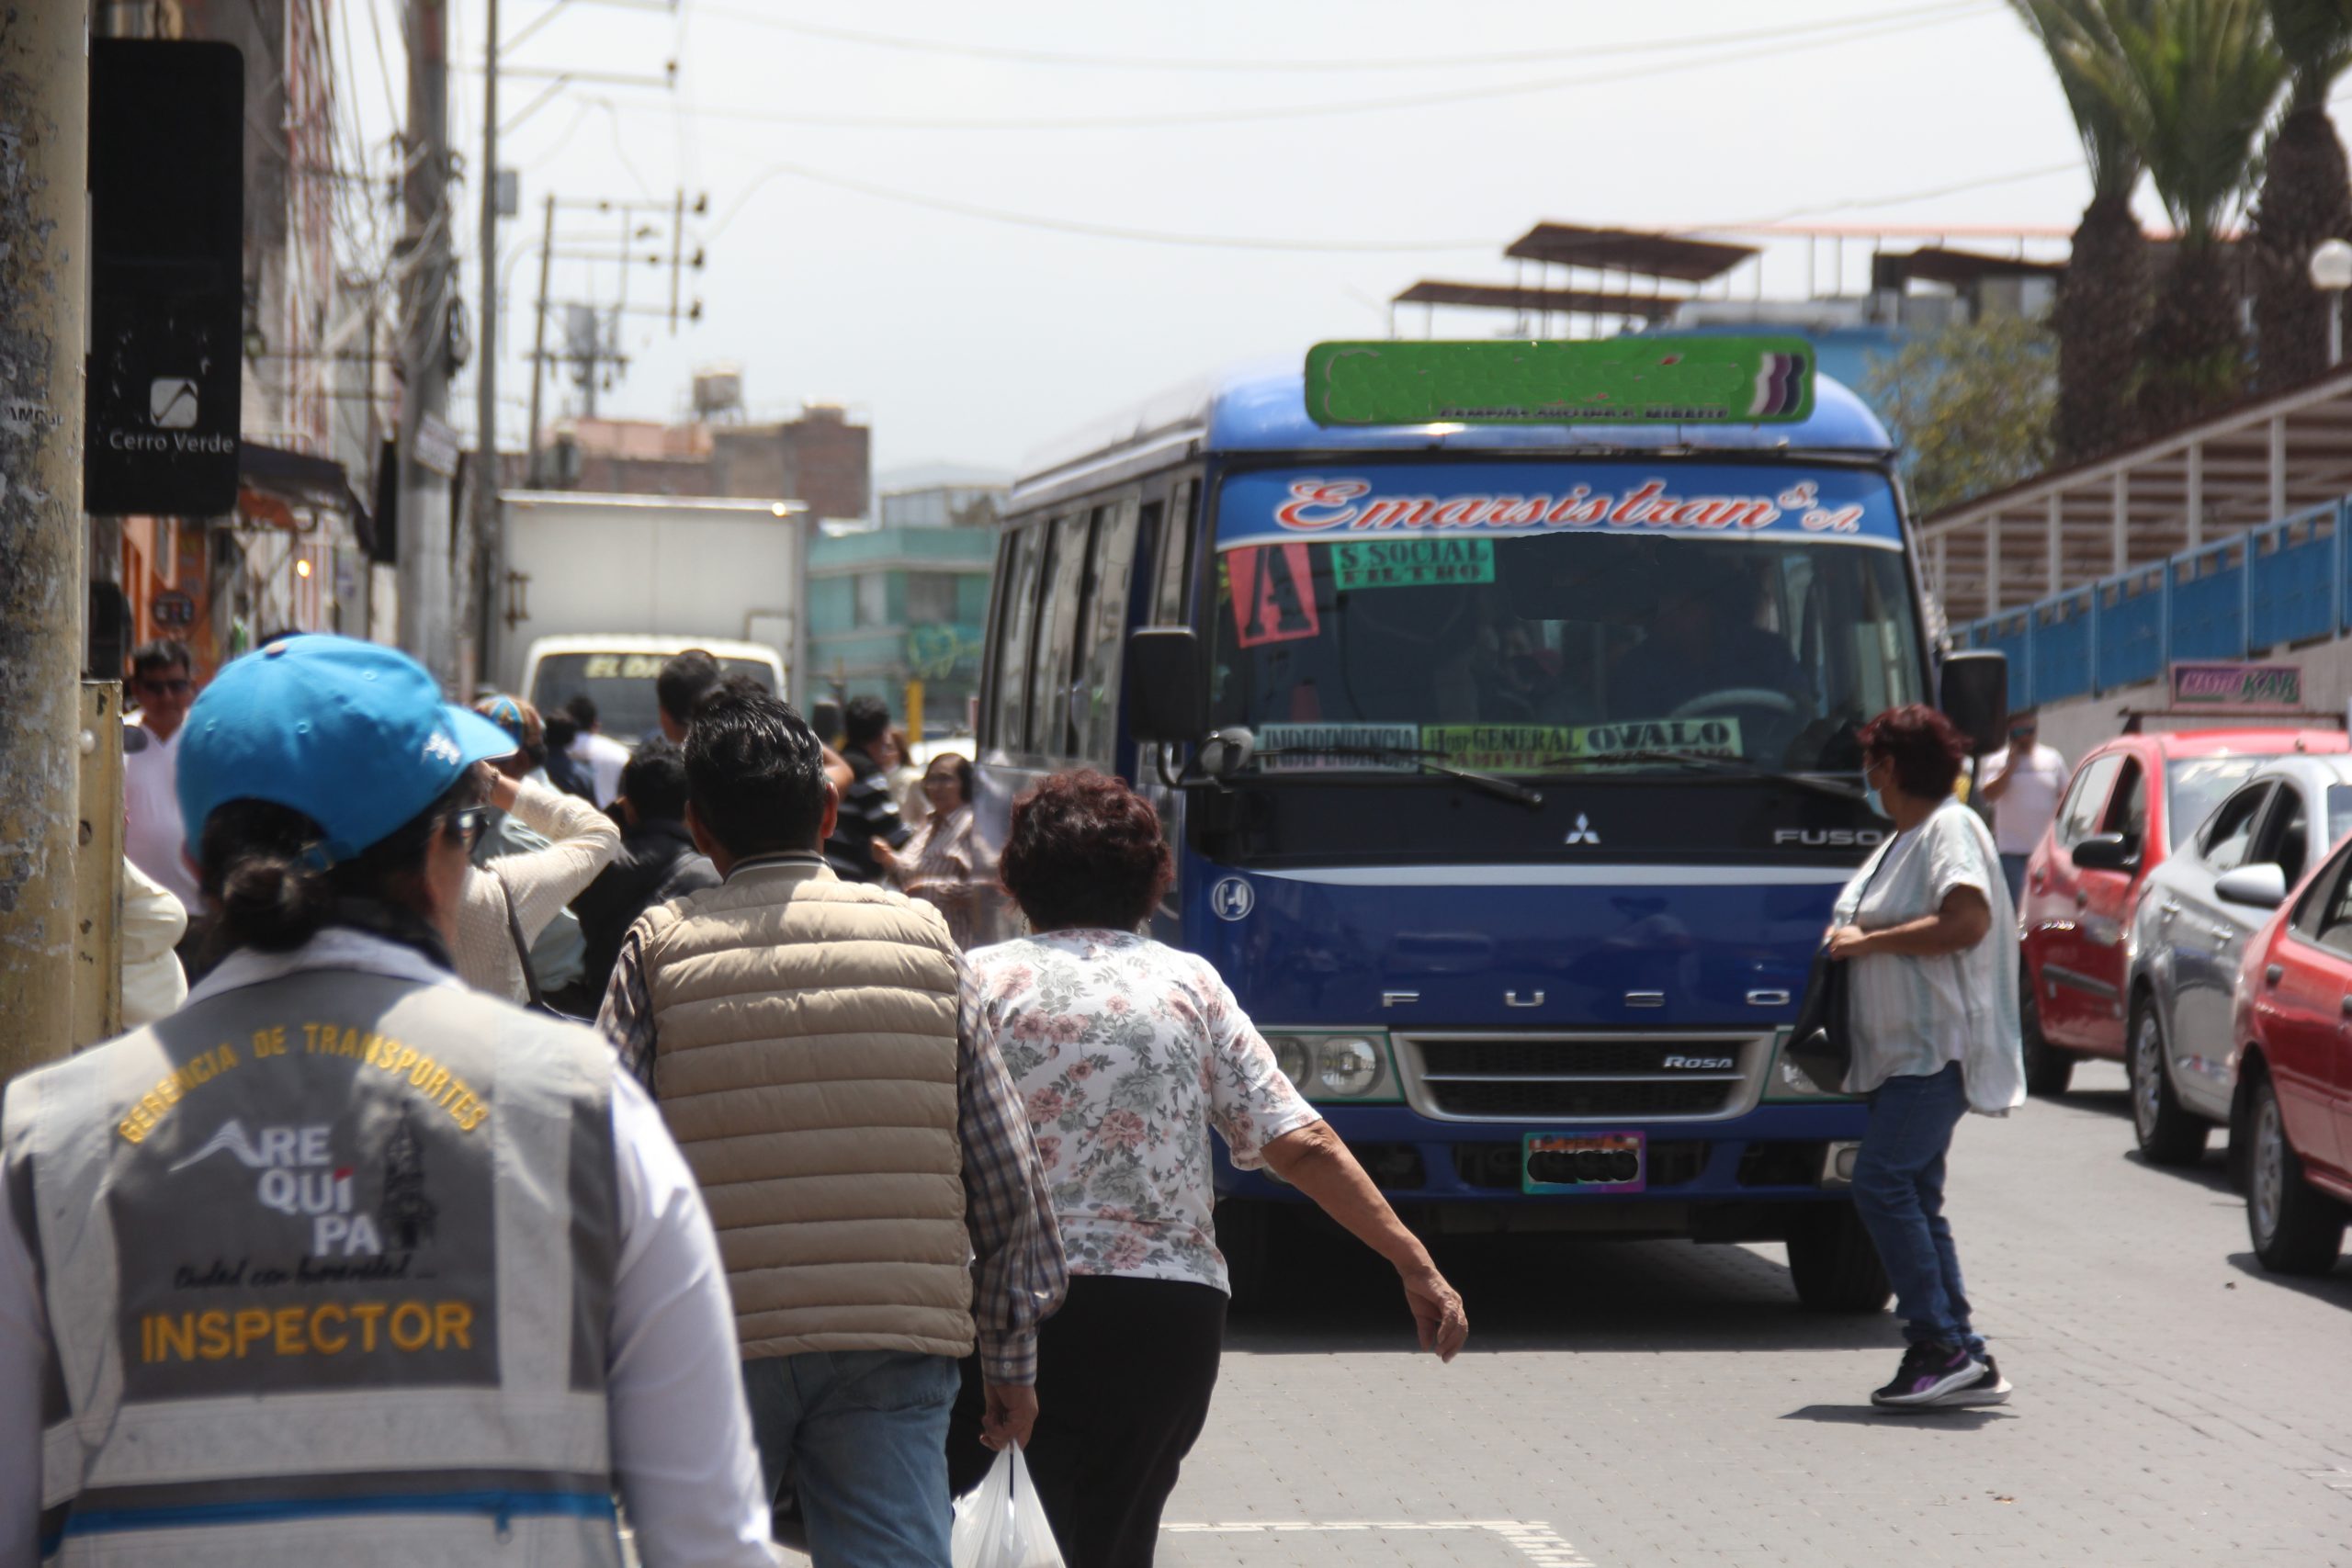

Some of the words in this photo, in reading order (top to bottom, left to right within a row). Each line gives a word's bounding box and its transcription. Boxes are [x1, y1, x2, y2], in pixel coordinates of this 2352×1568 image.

[109, 431, 167, 452] Cerro
[173, 432, 234, 454] Verde
[1275, 477, 1781, 531] Emarsistran
[1368, 540, 1489, 565] SOCIAL
[1244, 544, 1312, 638] A
[1472, 728, 1581, 753] GENERAL
[1587, 721, 1732, 753] OVALO
[1774, 829, 1883, 846] FUSO
[119, 1043, 240, 1145] GERENCIA
[253, 1025, 289, 1059] DE
[303, 1021, 490, 1134] TRANSPORTES
[313, 1213, 383, 1258] PA
[141, 1300, 474, 1363] INSPECTOR
